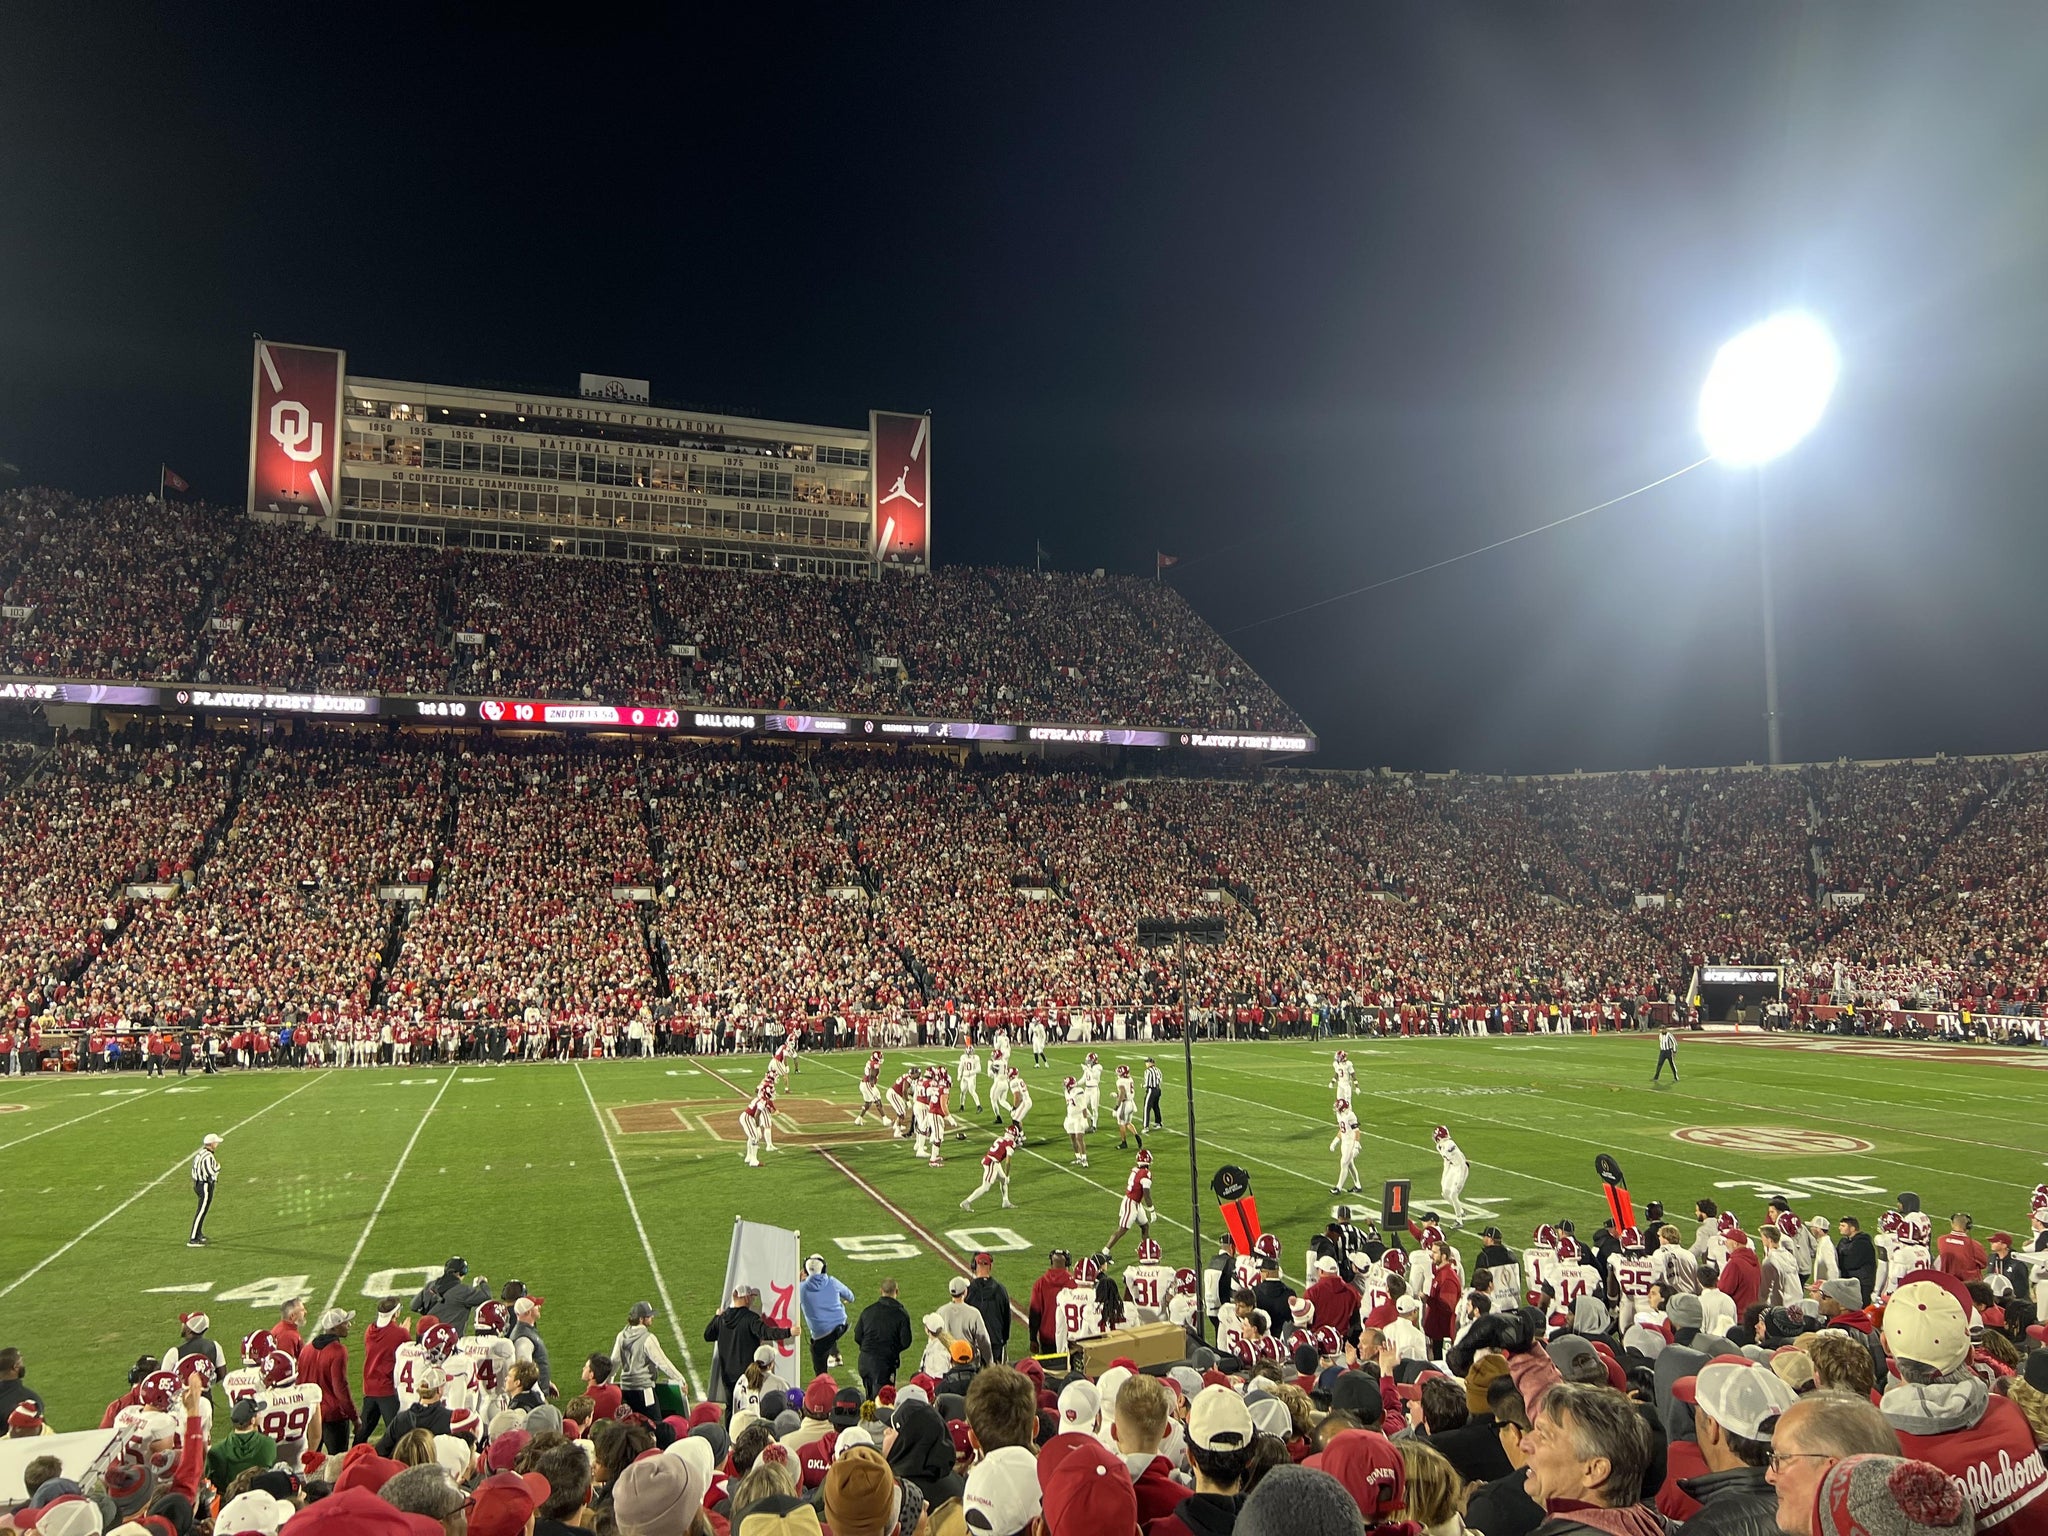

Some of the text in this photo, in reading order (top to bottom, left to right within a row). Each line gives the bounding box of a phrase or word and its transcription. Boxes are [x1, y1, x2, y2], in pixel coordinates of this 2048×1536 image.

[516, 403, 726, 434] UNIVERSITY OF OKLAHOMA
[270, 400, 322, 462] OU
[369, 422, 515, 445] 1950 1955 1956 1974
[539, 438, 697, 463] NATIONAL CHAMPIONS
[723, 457, 744, 467] 1975
[794, 464, 816, 474] 2000
[392, 471, 559, 493] 50 CONFERENCE CHAMPIONSHIPS
[585, 488, 708, 507] 31 BOWL CHAMPIONSHIPS
[755, 504, 830, 518] ALL-AMERICANS
[9, 608, 25, 617] 103
[193, 691, 366, 713] PLAYOFF FIRST ROUND
[417, 701, 437, 715] 1st
[450, 703, 466, 716] 10
[513, 704, 534, 720] 10
[631, 709, 644, 725] 0
[695, 713, 723, 728] BALL
[724, 714, 740, 728] ON
[1191, 734, 1238, 748] PLAYOFF
[1238, 736, 1269, 748] FIRST
[1391, 1185, 1402, 1213] 1
[1532, 1259, 1543, 1286] 1
[1561, 1269, 1583, 1278] HENRY
[1133, 1278, 1160, 1307] 31
[1619, 1270, 1652, 1296] 25
[1560, 1280, 1587, 1307] 14
[464, 1345, 490, 1356] CARTER
[158, 1377, 172, 1391] 85
[272, 1392, 305, 1407] DALTON
[263, 1406, 310, 1444] 89
